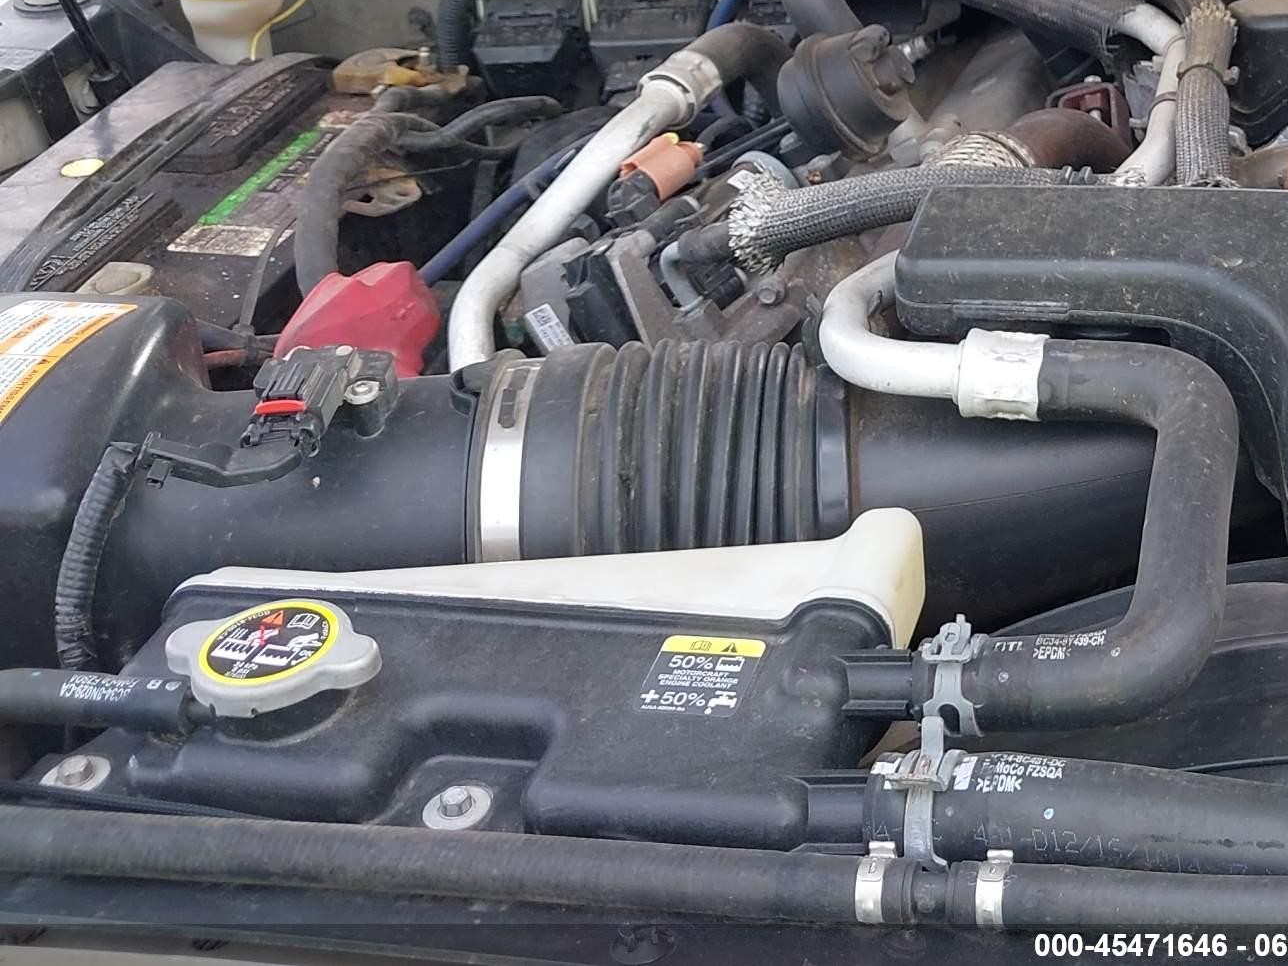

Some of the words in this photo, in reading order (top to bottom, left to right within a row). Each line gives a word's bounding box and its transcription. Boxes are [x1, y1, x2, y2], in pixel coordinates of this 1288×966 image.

[668, 655, 714, 670] 50%
[672, 669, 730, 677] MOTORCRAFT
[658, 674, 702, 682] SPECIALTY
[704, 675, 738, 684] ORANGE
[659, 679, 690, 687] ENGINE
[691, 681, 731, 689] COOLANT
[1025, 764, 1063, 779] FZSQA
